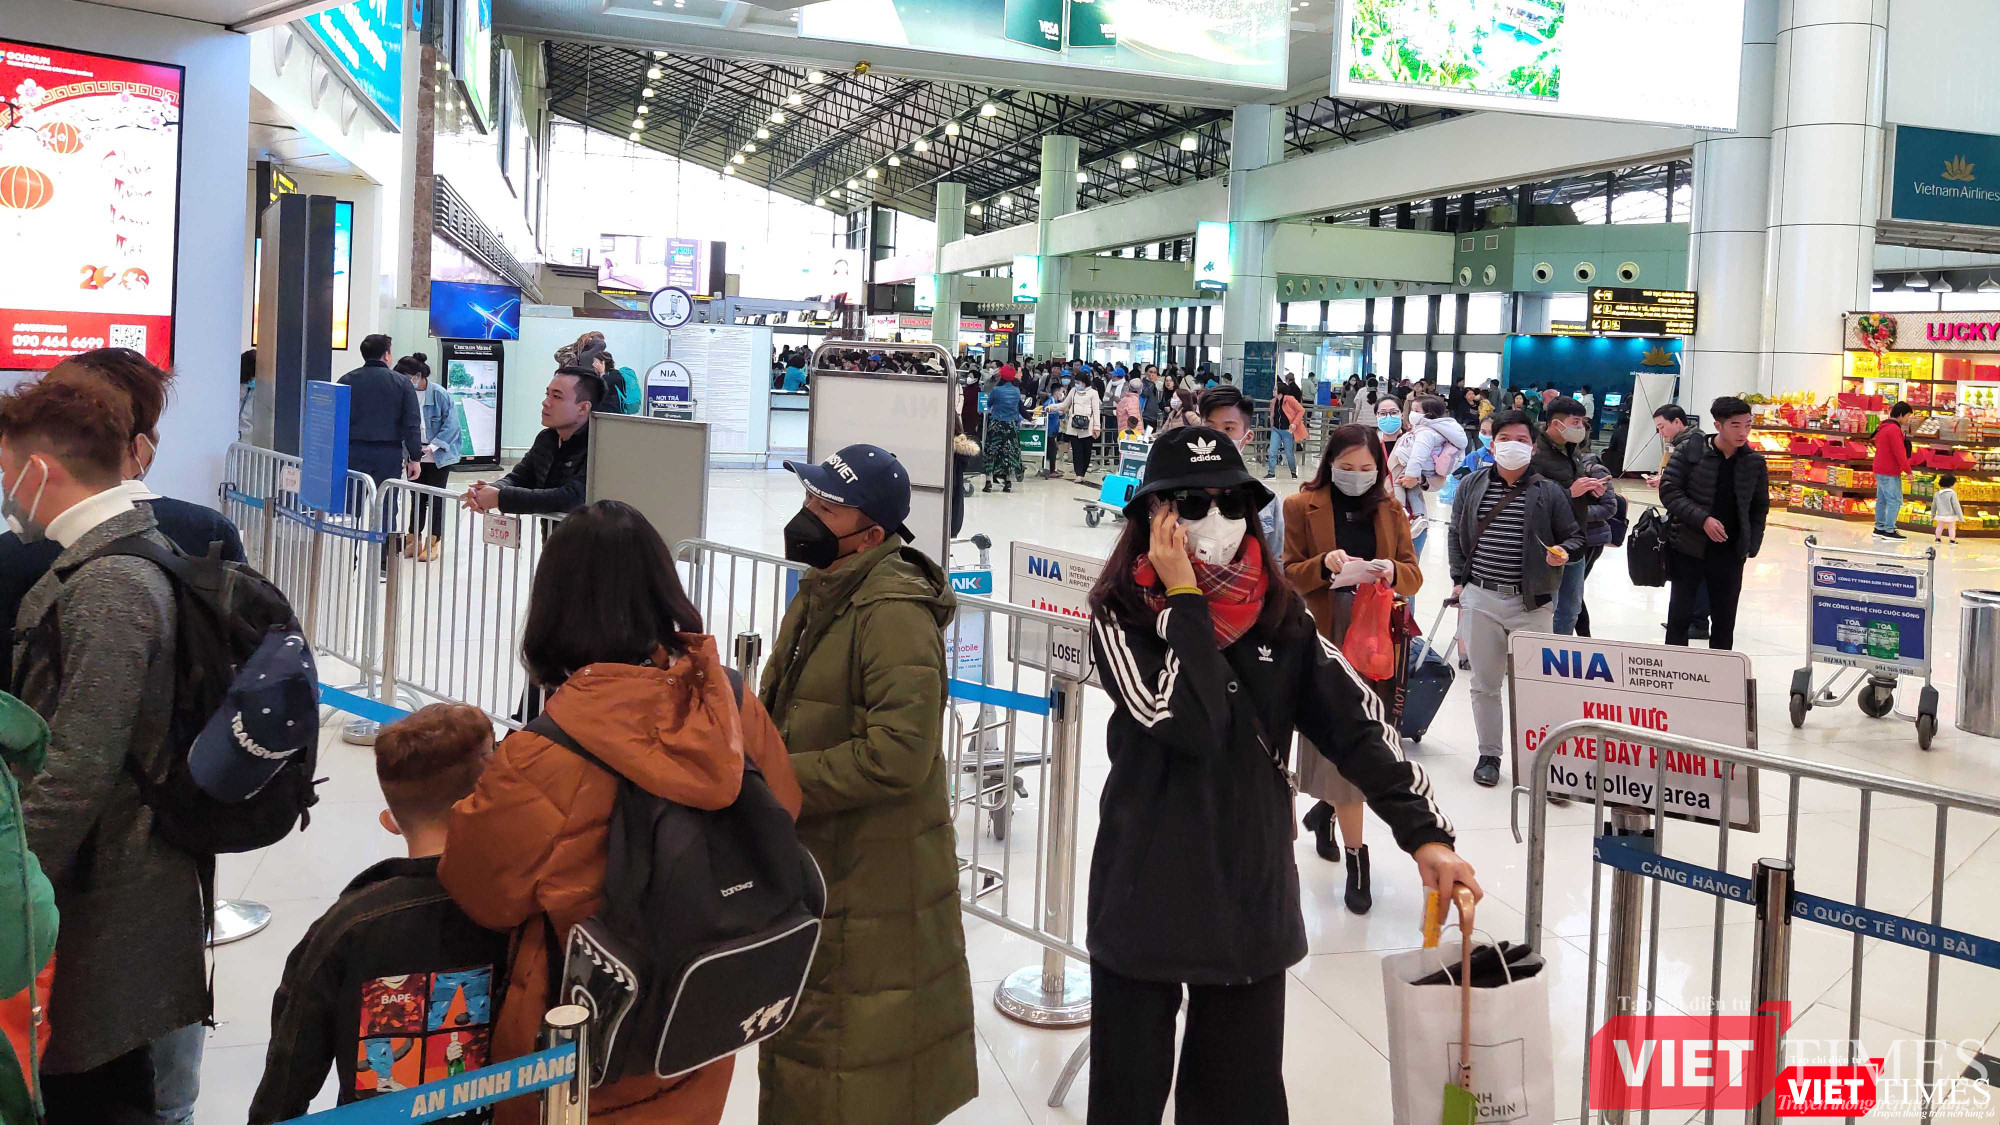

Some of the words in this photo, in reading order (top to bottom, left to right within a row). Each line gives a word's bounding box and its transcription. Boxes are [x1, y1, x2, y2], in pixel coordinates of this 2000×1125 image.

[6, 51, 51, 66] GOLDSUN
[1913, 181, 1959, 198] Vietnam
[1959, 186, 2000, 202] Airlines
[1926, 321, 2000, 342] LUCKY
[12, 334, 40, 347] 090
[41, 335, 69, 348] 464
[70, 336, 105, 349] 6699
[660, 369, 677, 378] NIA
[1190, 454, 1222, 463] adidas
[1028, 555, 1063, 582] NIA
[1069, 564, 1086, 574] NOIBAI
[1068, 578, 1090, 589] AIRPORT
[1818, 573, 1835, 581] TOA
[1837, 576, 1851, 584] CÔNG
[1832, 602, 1850, 611] CÔNG
[1850, 605, 1868, 614] NGHỆ
[1868, 607, 1883, 615] CHO
[1882, 609, 1901, 618] CUỘC
[1844, 619, 1861, 627] TOA
[1876, 622, 1893, 631] TOA
[1541, 647, 1615, 683] NIA
[1628, 656, 1663, 668] NOIBAI
[1628, 666, 1711, 683] INTERNATIONAL
[1629, 677, 1674, 690] AIRPORT
[1392, 686, 1406, 716] LOVE
[1583, 701, 1622, 722] KHU
[1573, 736, 1598, 760] XE
[1550, 764, 1578, 787] No
[1585, 770, 1654, 804] trolley
[1663, 786, 1711, 810] area
[1640, 860, 1687, 885] CẢNG
[1692, 871, 1741, 899] HÀNG
[1813, 901, 1868, 930] QUỐC
[1872, 918, 1899, 937] TẾ
[1901, 926, 1937, 948] NỘI
[1943, 933, 1977, 957] BÀI
[381, 993, 412, 1005] BAPE
[410, 1088, 446, 1118] AN
[452, 1070, 511, 1106] NINH
[517, 1051, 577, 1088] HÀNG
